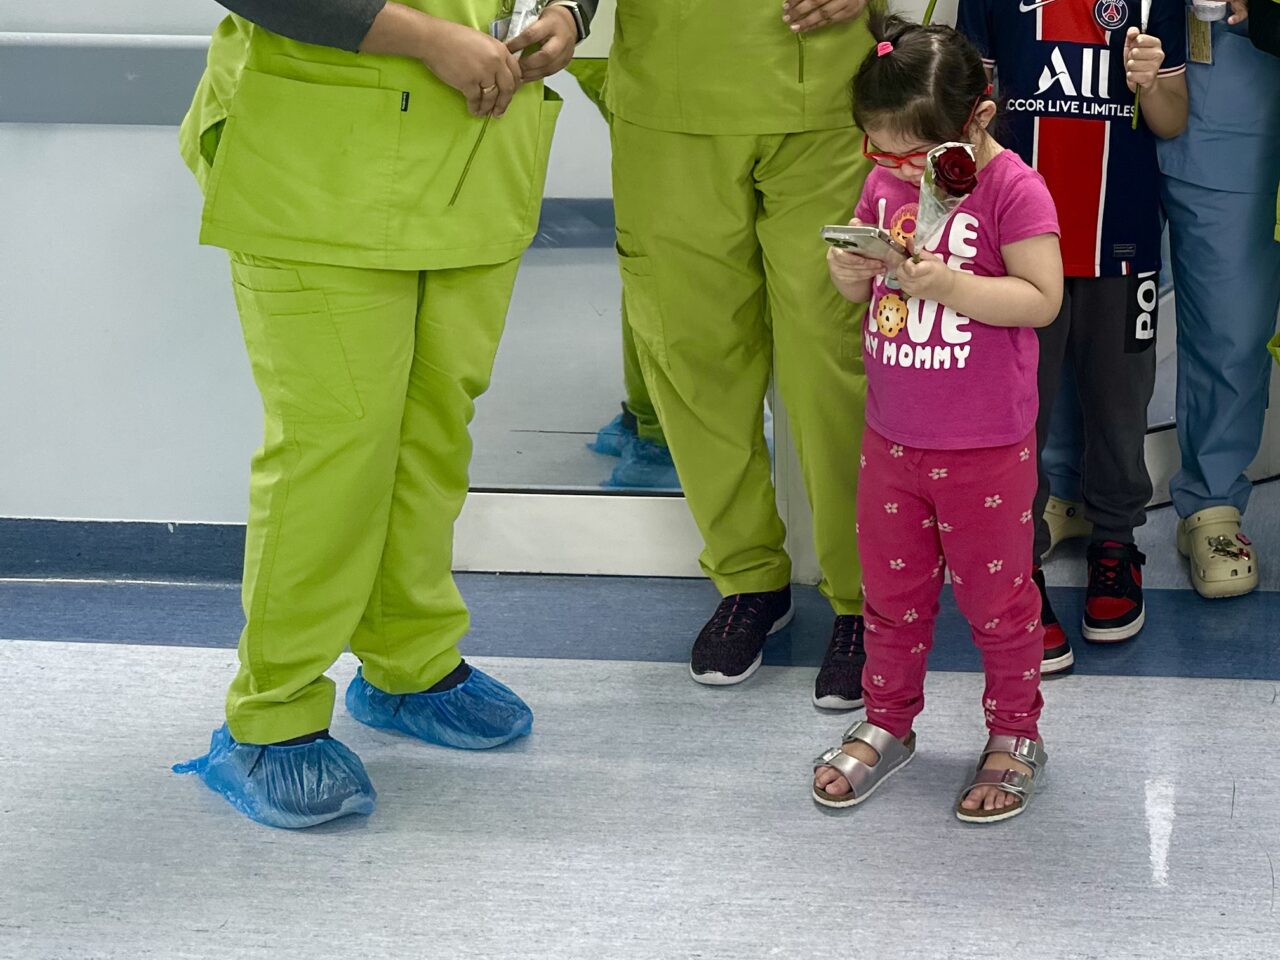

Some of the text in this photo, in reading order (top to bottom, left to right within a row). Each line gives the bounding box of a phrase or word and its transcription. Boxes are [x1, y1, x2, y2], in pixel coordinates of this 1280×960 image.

[1006, 99, 1136, 117] CCOR LIVE LIMITLES
[882, 341, 971, 370] MOMMY
